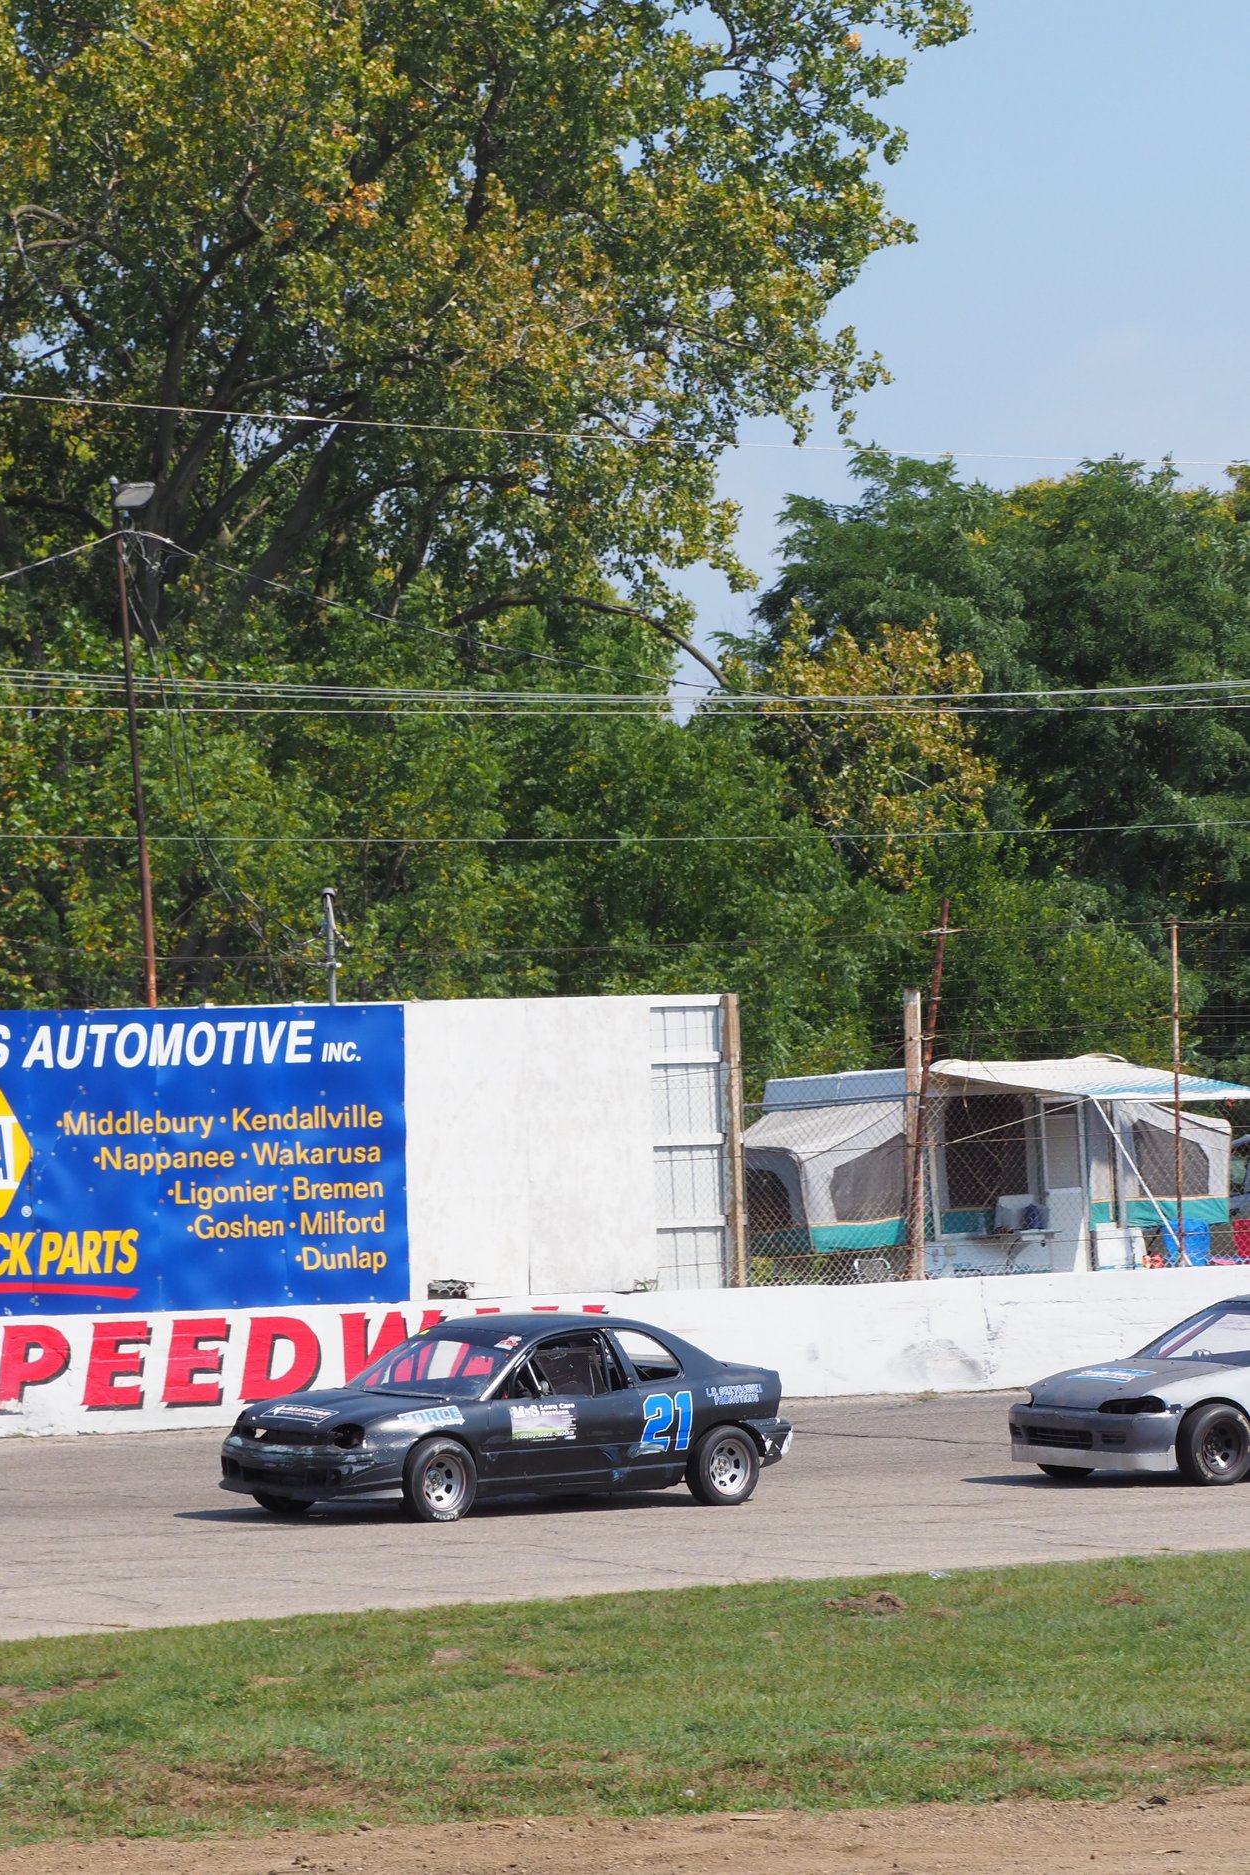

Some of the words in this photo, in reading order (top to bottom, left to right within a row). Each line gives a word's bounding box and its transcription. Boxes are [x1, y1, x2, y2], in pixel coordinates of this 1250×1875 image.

[21, 1020, 316, 1070] AUTOMOTIVE
[321, 1040, 362, 1063] INC.
[65, 1110, 214, 1139] Middlebury
[232, 1104, 383, 1131] Kendallville
[100, 1146, 235, 1175] Nappanee
[252, 1142, 381, 1166] Wakarusa
[174, 1181, 277, 1207] Ligonier
[293, 1176, 384, 1201] Bremen
[195, 1214, 285, 1240] Goshen
[300, 1210, 385, 1235] Milford
[37, 1228, 139, 1276] PARTS
[302, 1246, 387, 1273] Dunlap
[640, 1390, 693, 1453] 21
